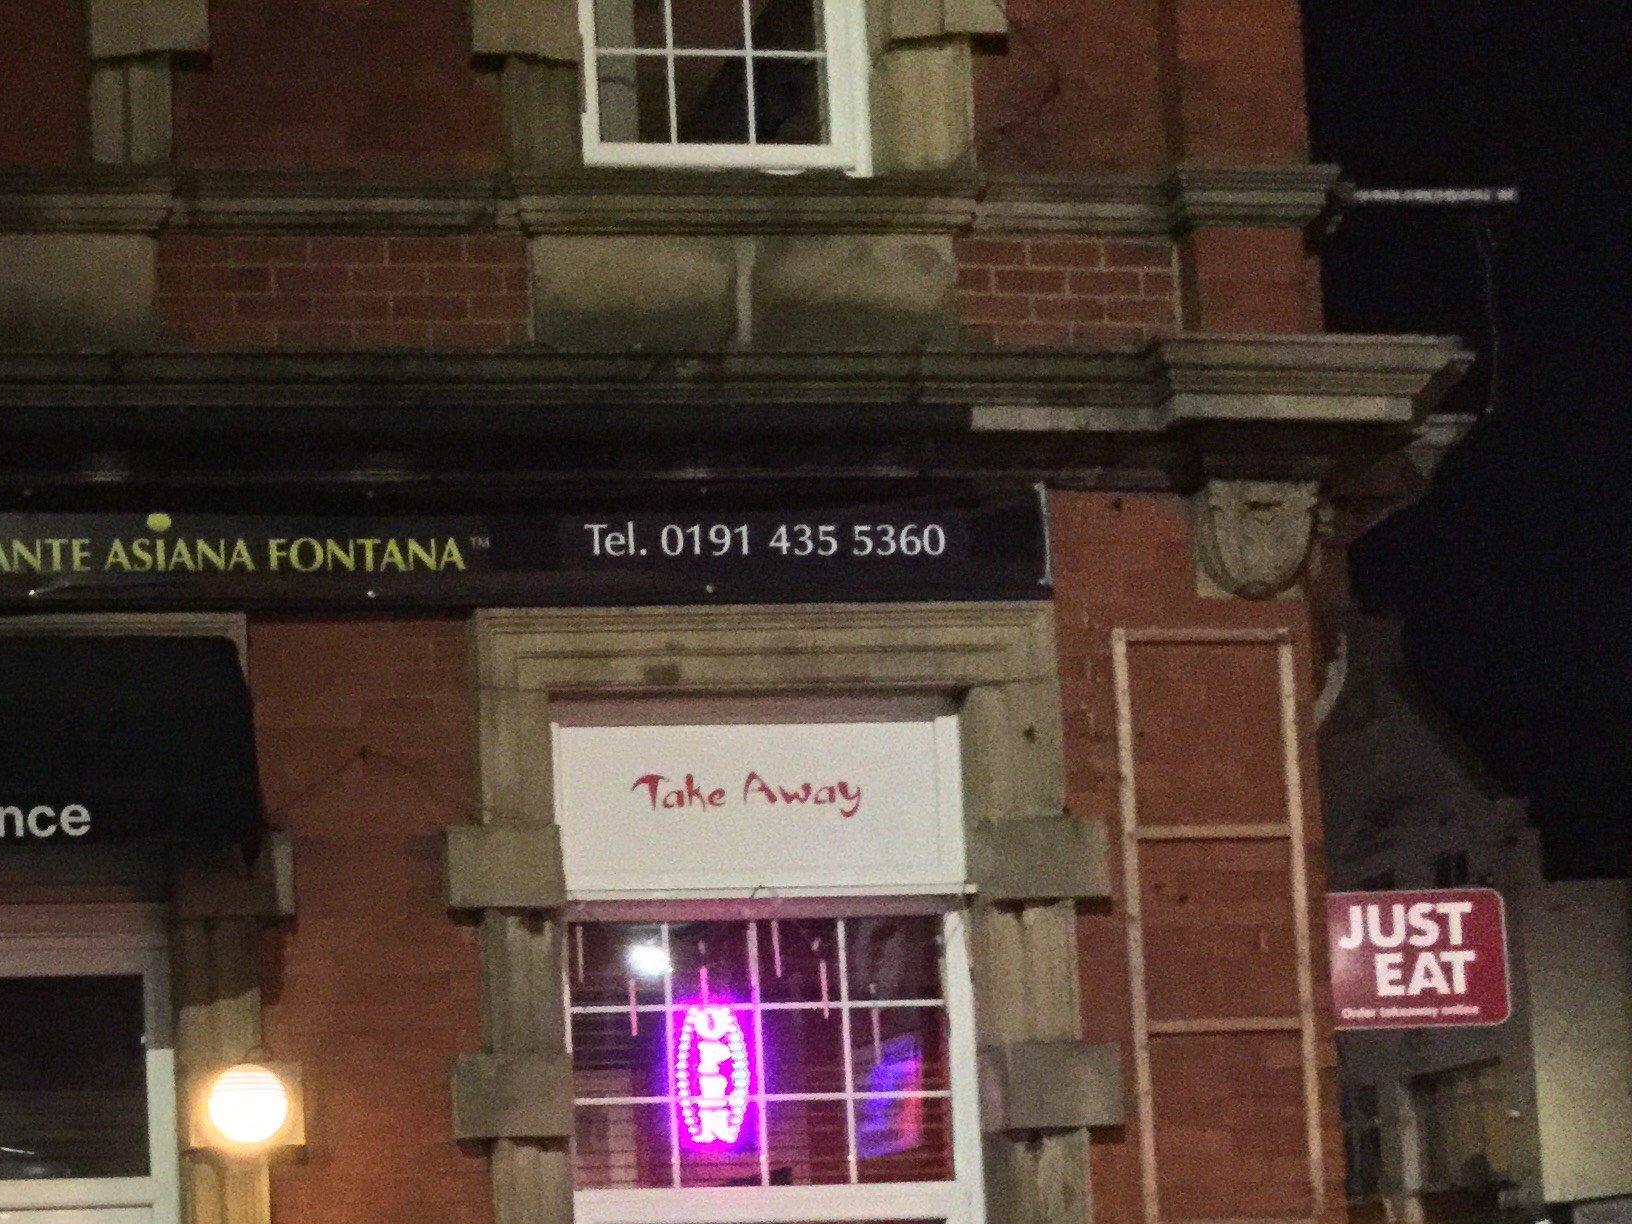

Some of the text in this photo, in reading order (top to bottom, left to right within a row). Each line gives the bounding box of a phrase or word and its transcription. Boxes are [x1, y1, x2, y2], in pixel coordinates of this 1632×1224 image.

[104, 513, 256, 572] ASIANA
[268, 536, 466, 572] FONTANA
[584, 521, 946, 557] Tel. 0191 435 5360
[631, 770, 862, 819] Take Away
[1338, 900, 1473, 950] JUST
[1374, 950, 1476, 998] EAT
